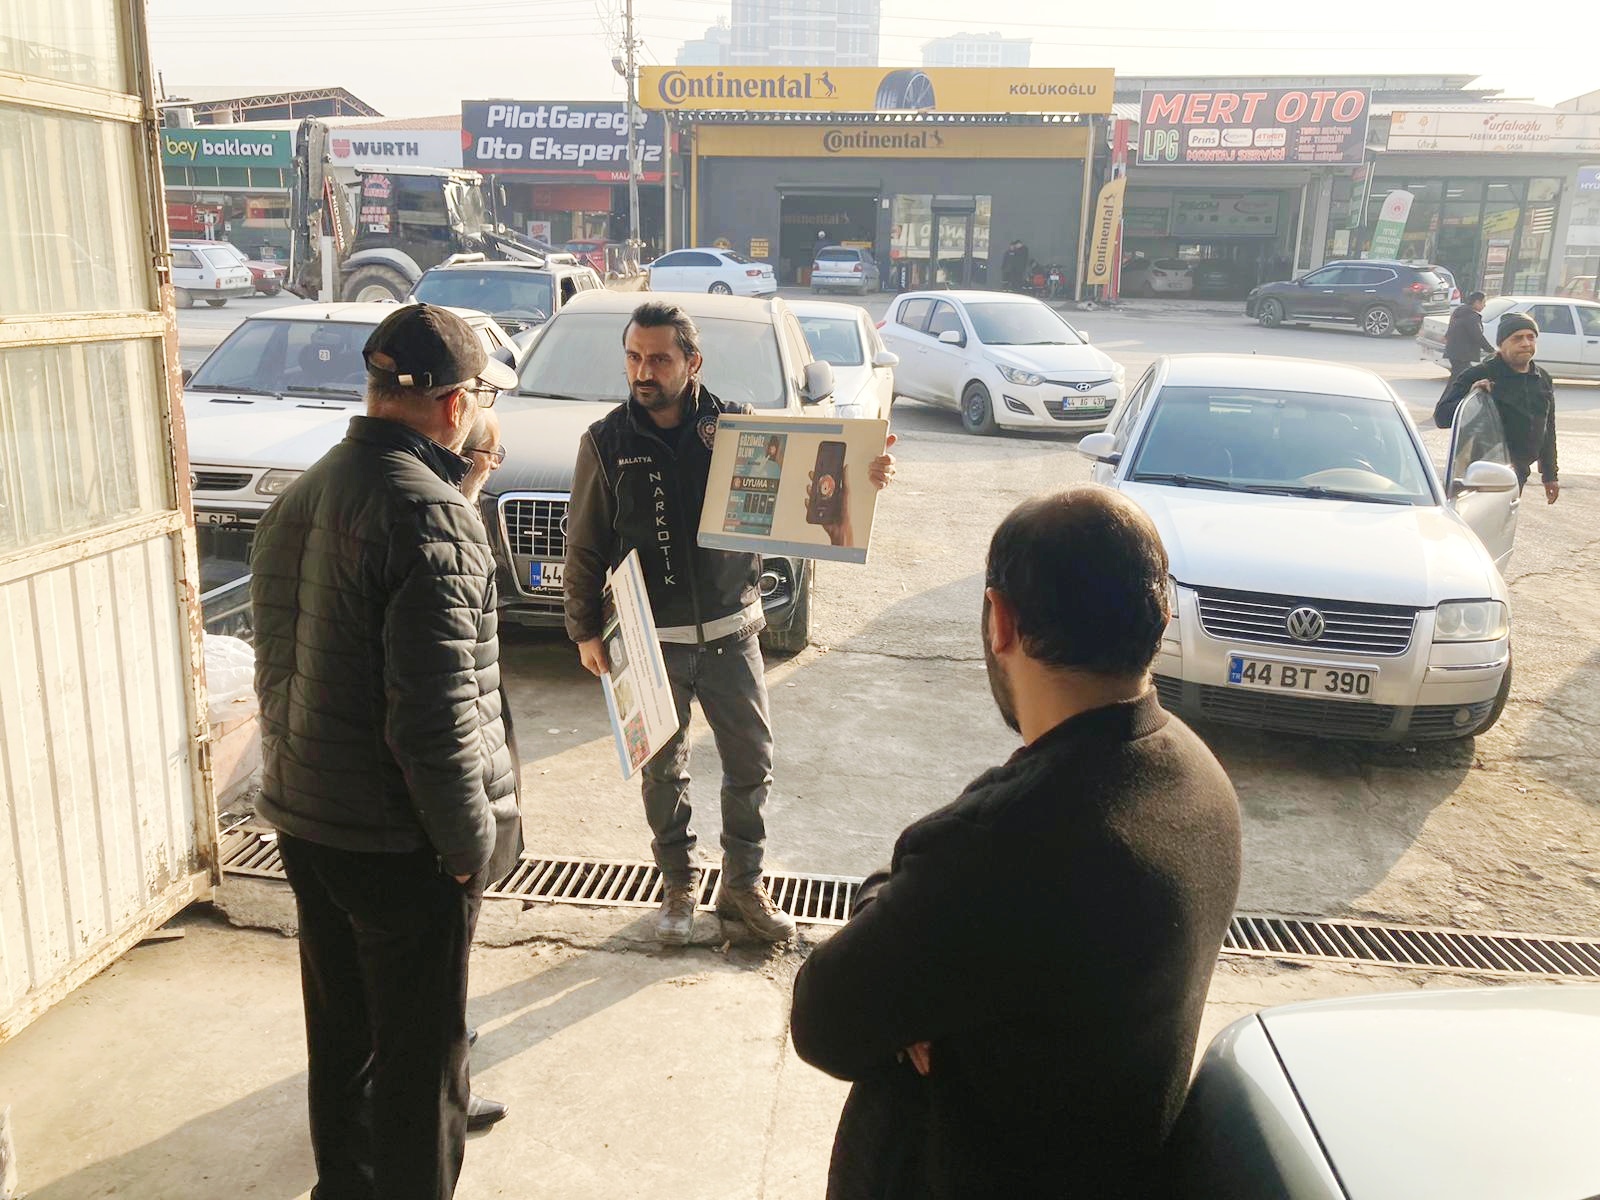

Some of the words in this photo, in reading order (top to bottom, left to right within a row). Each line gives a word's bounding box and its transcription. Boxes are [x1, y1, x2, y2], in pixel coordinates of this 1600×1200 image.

[658, 70, 811, 104] Continental
[1009, 82, 1096, 95] KÖLÜKOĞLU
[1146, 92, 1267, 124] MERT
[1275, 90, 1366, 123] OTO
[165, 135, 198, 161] bey
[202, 138, 273, 156] baklava
[476, 137, 524, 160] Oto
[823, 130, 927, 153] Continental
[1143, 129, 1180, 161] LPG
[1191, 135, 1216, 145] Prins
[1186, 149, 1236, 162] MONTAJ
[1093, 205, 1114, 276] Continental
[618, 456, 653, 466] MALATYA
[742, 478, 768, 489] UYUMA
[542, 565, 562, 584] 44
[1243, 662, 1272, 685] 44
[1280, 666, 1318, 690] BT
[1324, 671, 1370, 695] 390
